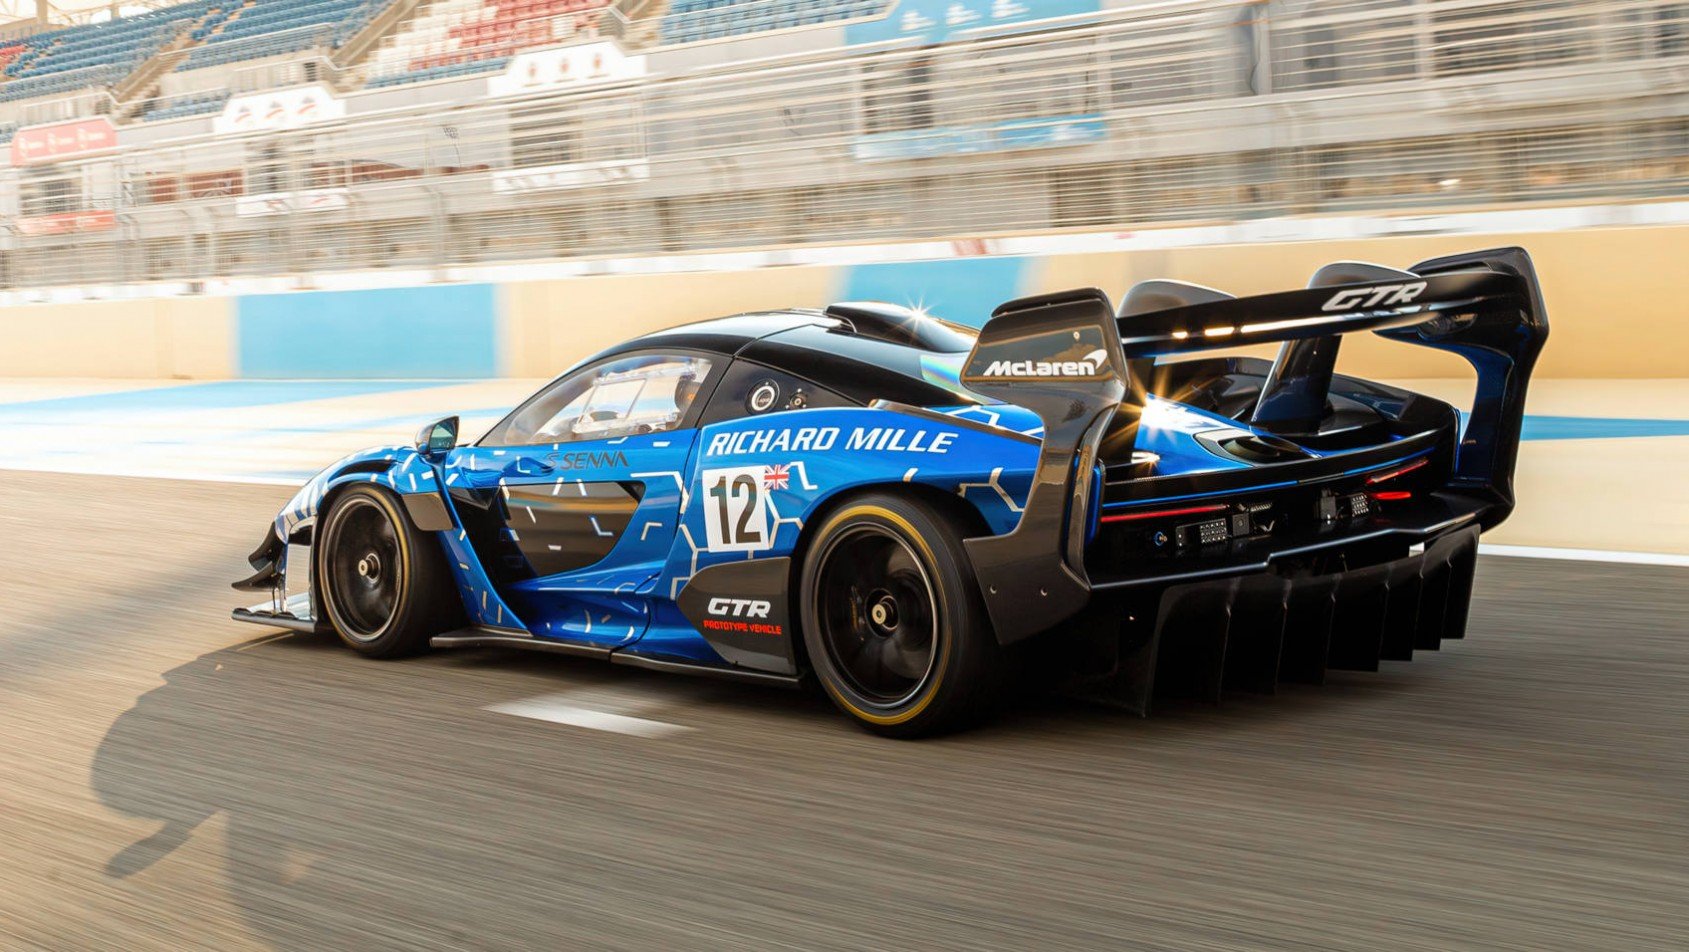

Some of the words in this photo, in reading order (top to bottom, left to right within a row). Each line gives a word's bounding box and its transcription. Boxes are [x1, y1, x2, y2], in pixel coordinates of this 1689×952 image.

[1321, 281, 1428, 311] GTR
[982, 360, 1096, 376] McLaren
[706, 427, 840, 456] RICHARD
[845, 427, 959, 453] MILLE
[561, 450, 630, 470] SENNA
[709, 473, 762, 545] 12
[707, 597, 771, 618] GTR
[703, 619, 749, 632] PROTOTYPE
[749, 623, 782, 635] VEHICLE
